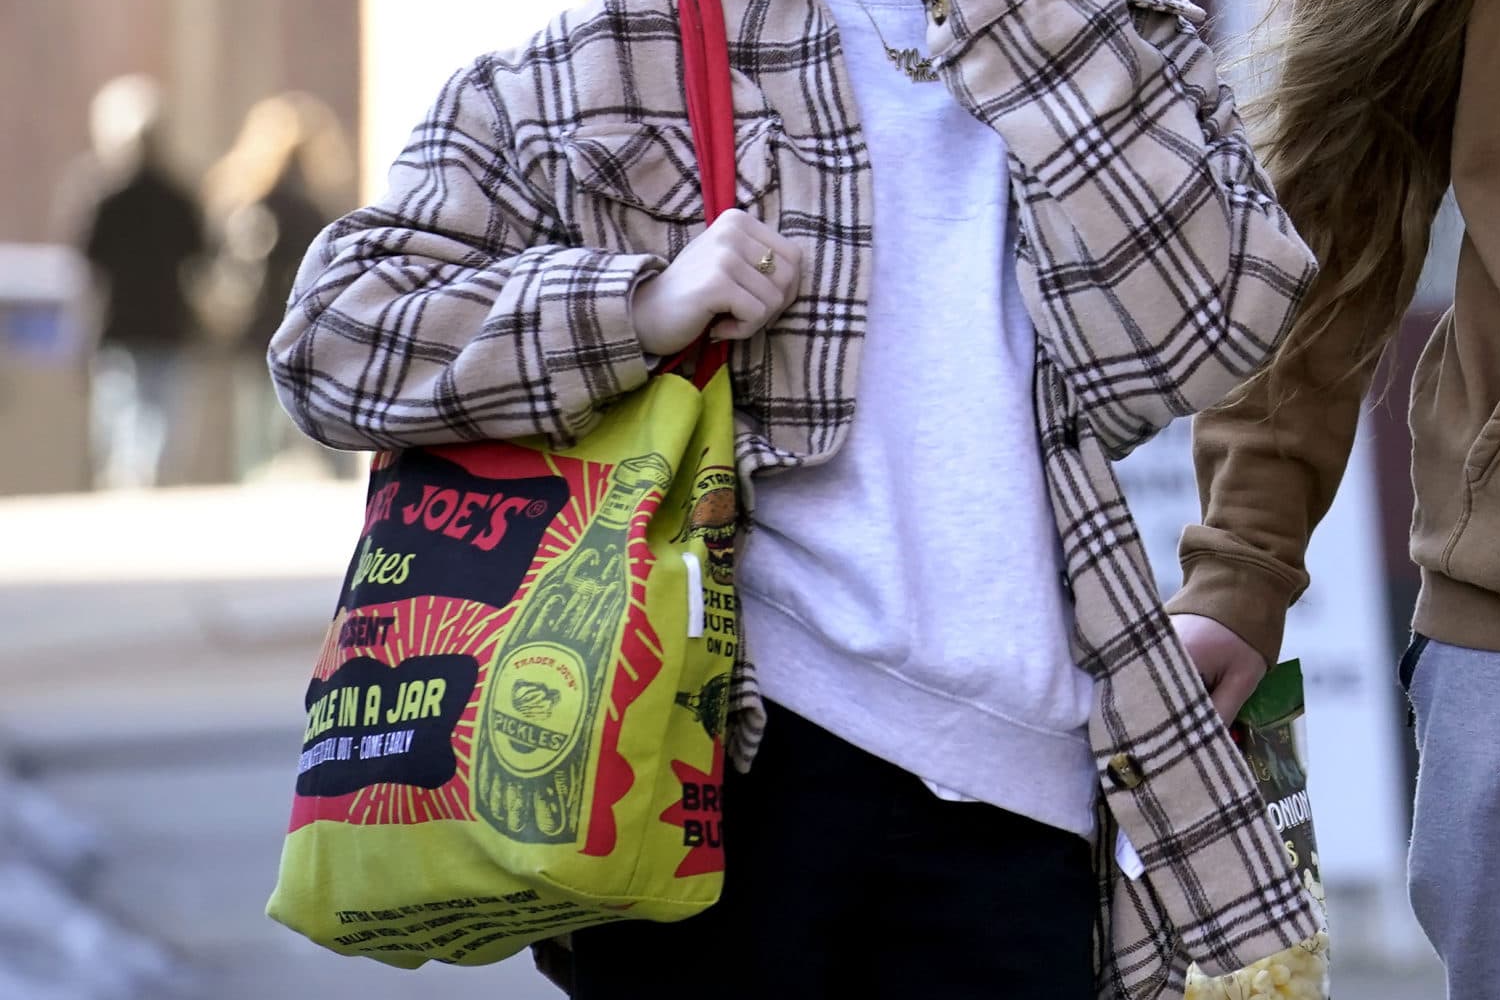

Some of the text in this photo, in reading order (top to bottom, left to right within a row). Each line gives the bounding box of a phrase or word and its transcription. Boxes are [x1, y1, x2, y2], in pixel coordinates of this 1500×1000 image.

[338, 686, 360, 727] IN
[363, 685, 381, 726] A
[386, 678, 446, 724] JAR
[495, 713, 564, 750] PICKLES
